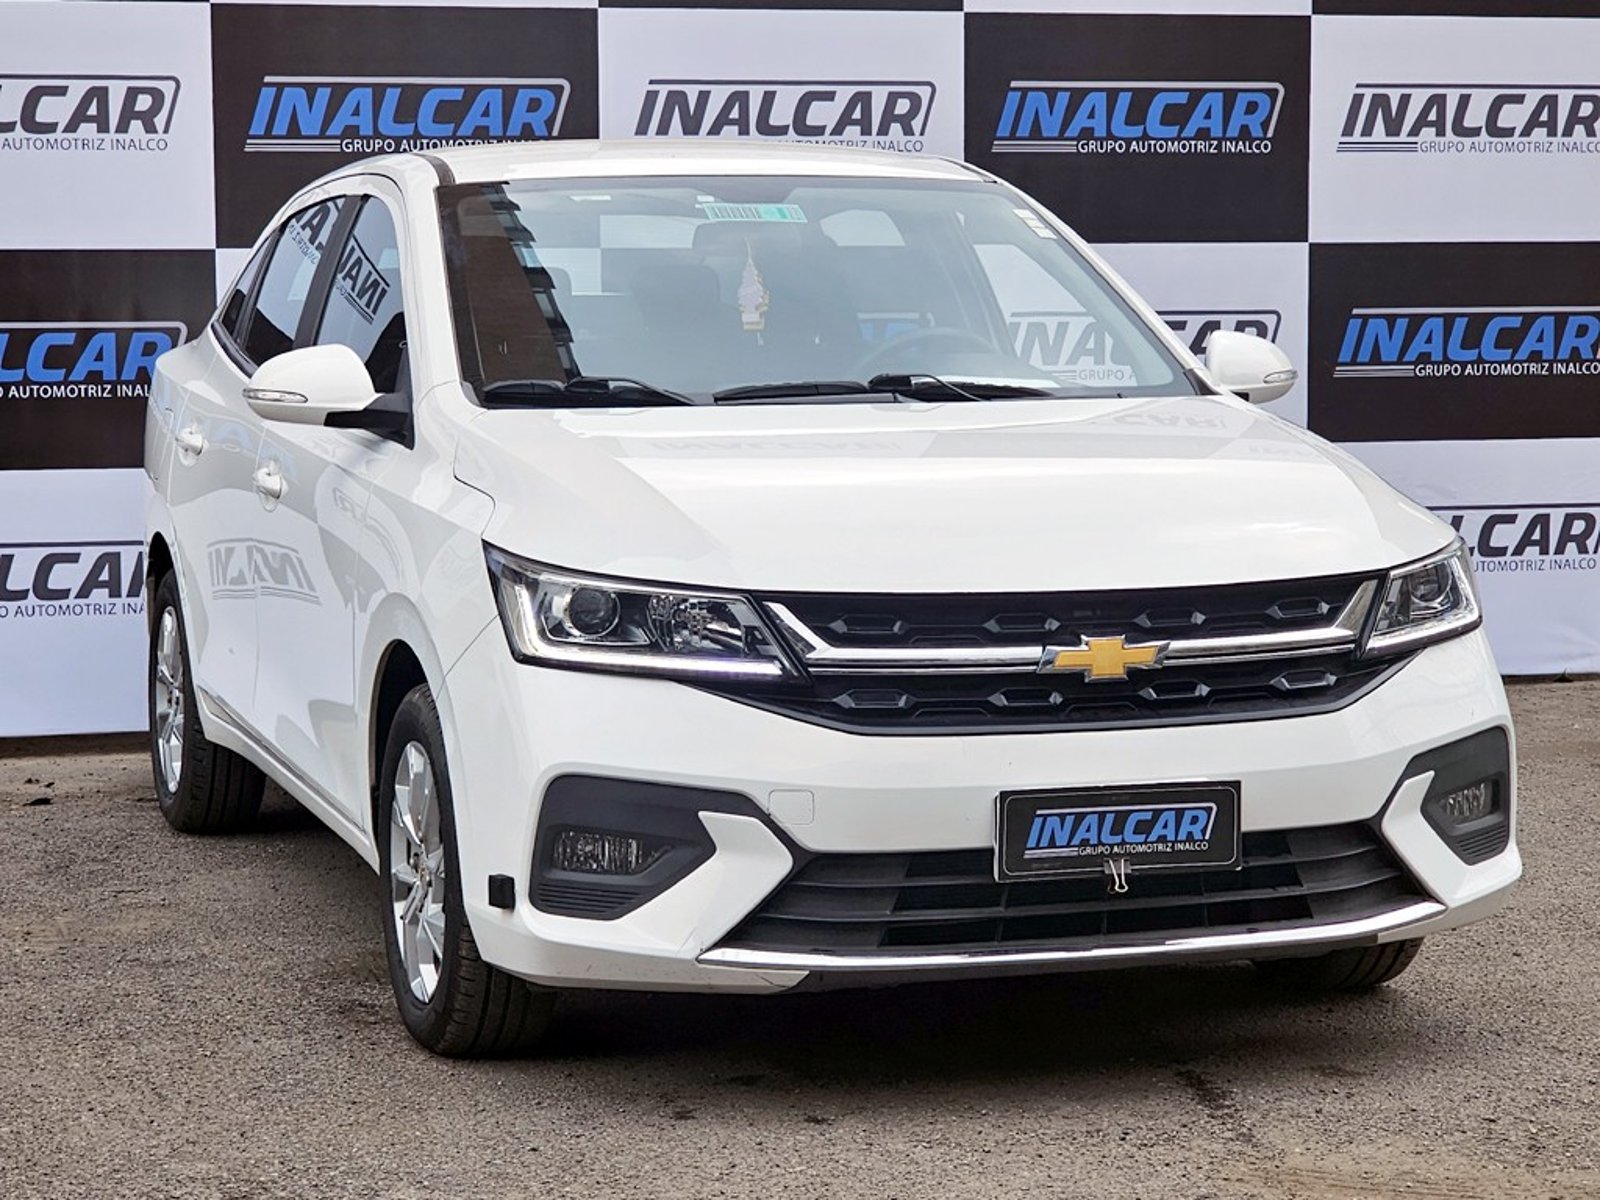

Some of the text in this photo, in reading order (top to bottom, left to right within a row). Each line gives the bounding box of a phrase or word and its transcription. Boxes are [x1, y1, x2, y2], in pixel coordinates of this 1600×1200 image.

[248, 87, 556, 137] INALCAR
[634, 89, 924, 137] INALCAR
[996, 91, 1272, 138] INALCAR
[1340, 93, 1600, 138] INALCAR
[2, 137, 168, 150] AUTOMOTRIZ INALCO
[342, 139, 395, 152] GRUPO
[872, 140, 924, 152] INALCO
[1077, 140, 1272, 153] GRUPO AUTOMOTRIZ INALCO
[1419, 141, 1465, 153] GRUPO
[1469, 141, 1553, 153] AUTOMOTRIZ
[1337, 315, 1600, 362] INALCAR
[1079, 369, 1125, 381] GRUPO
[1415, 361, 1600, 377] GRUPO AUTOMOTRIZ INALCO
[8, 385, 112, 398] AUTOMOTRIZ
[1474, 558, 1596, 572] UTOMOTRIZ INALCO
[14, 603, 117, 617] AUTOMOTRIZ
[1026, 809, 1208, 848] INALCAR
[1078, 841, 1209, 856] GRUPO AUTOMOTRIZ INALCO
